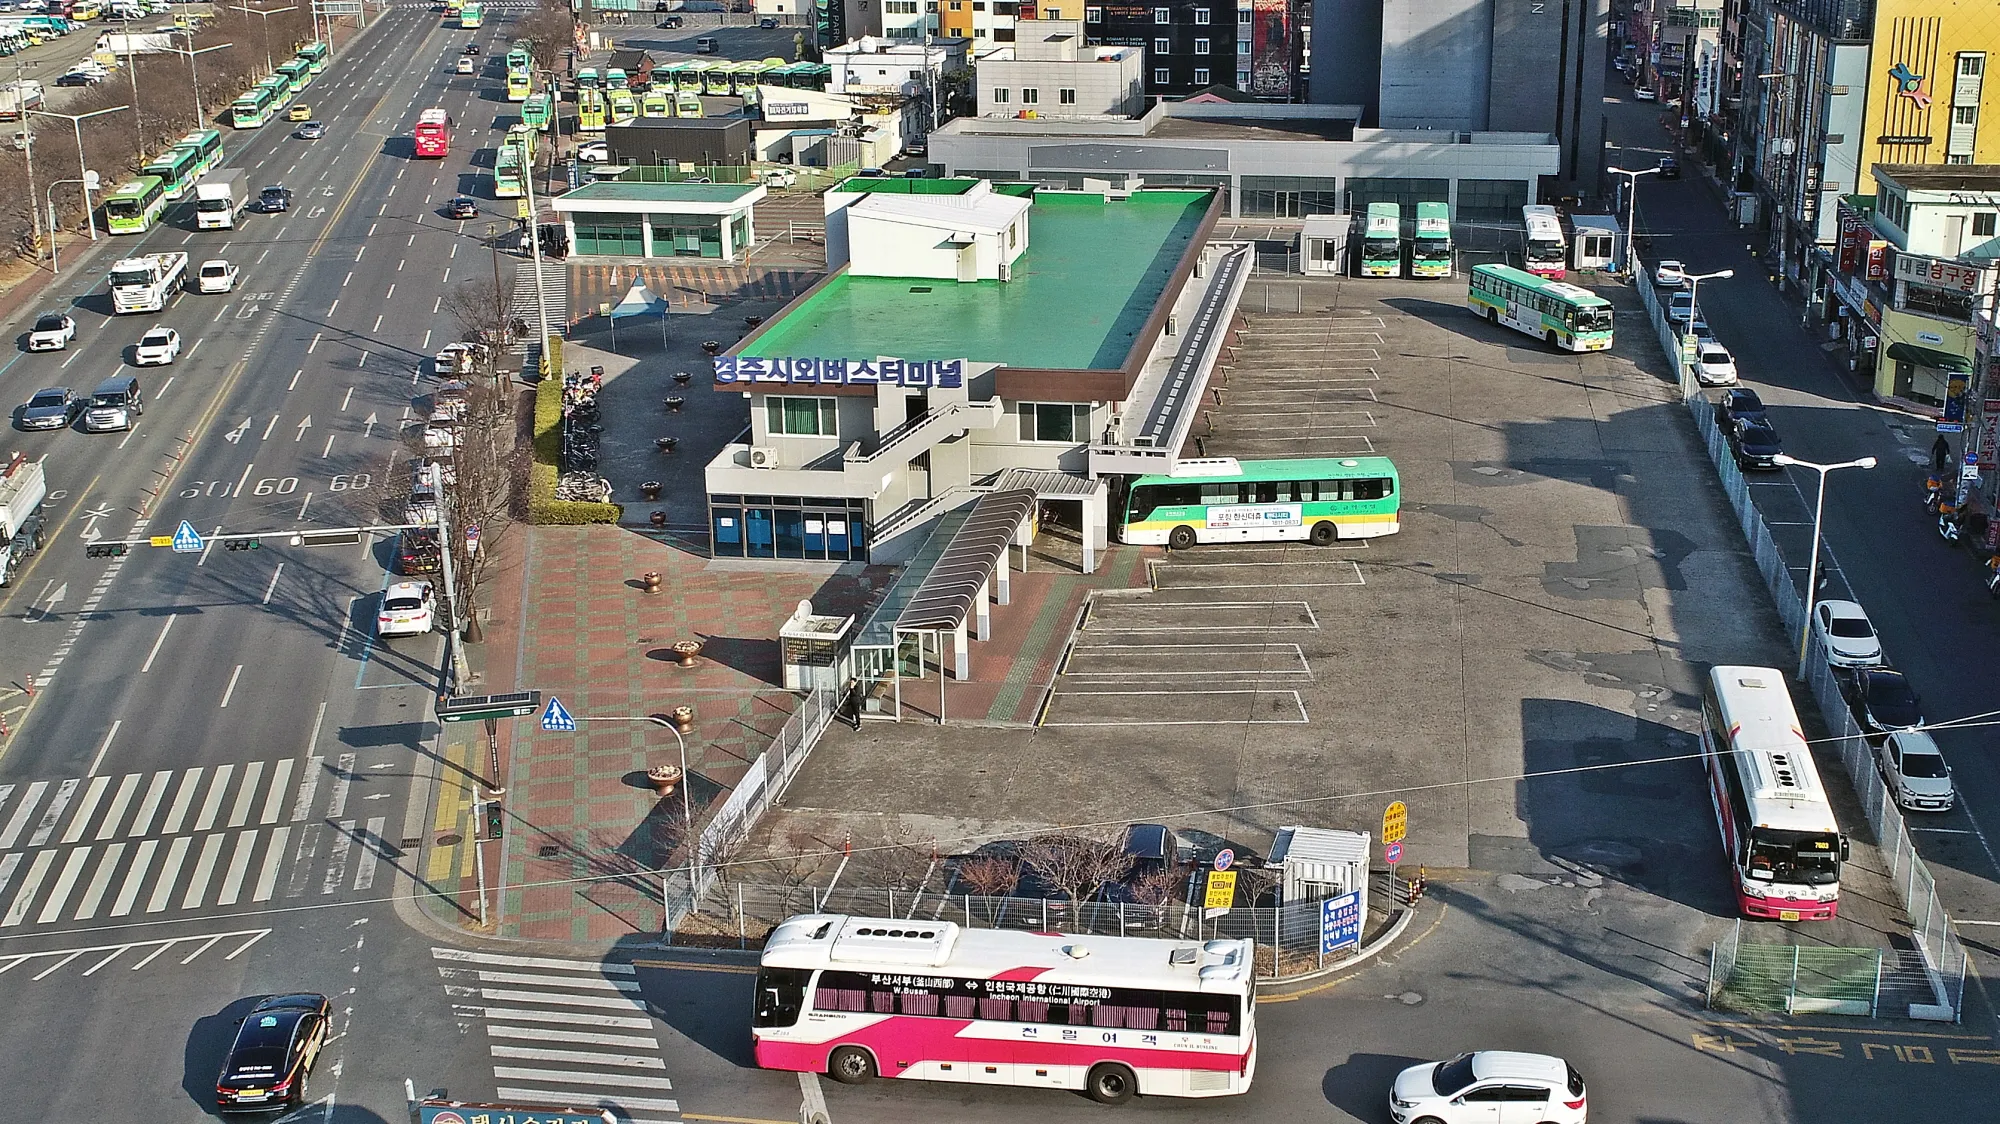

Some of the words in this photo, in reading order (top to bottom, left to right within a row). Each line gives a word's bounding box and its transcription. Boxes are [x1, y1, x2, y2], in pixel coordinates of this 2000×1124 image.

[1900, 258, 1976, 286] 대림당구장
[713, 356, 962, 388] 경주시외버스터미널
[253, 477, 299, 496] 60
[329, 473, 372, 492] 60
[1208, 898, 1230, 906] 단속중
[893, 986, 928, 995] W.Busan
[990, 993, 1019, 1001] Incheon
[1023, 994, 1070, 1004] International
[1074, 998, 1100, 1006] Airport
[1022, 1027, 1156, 1045] 천일여객
